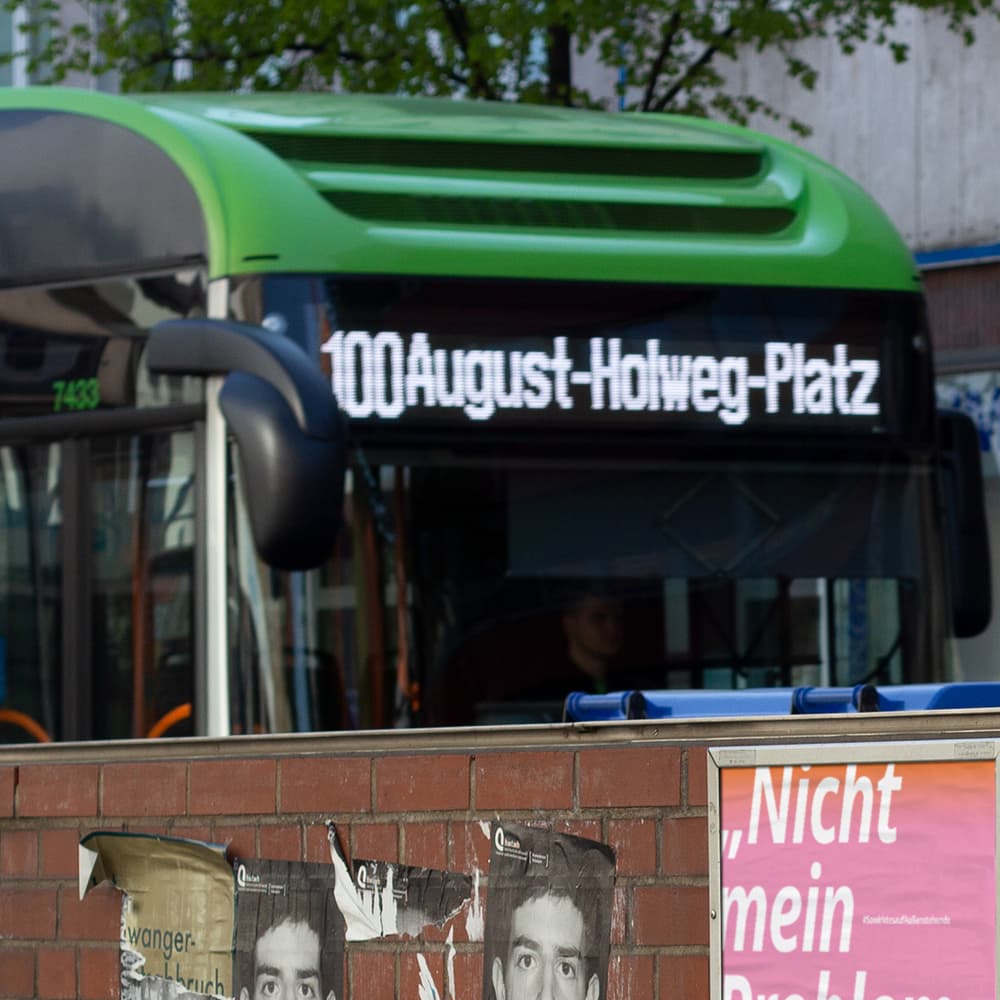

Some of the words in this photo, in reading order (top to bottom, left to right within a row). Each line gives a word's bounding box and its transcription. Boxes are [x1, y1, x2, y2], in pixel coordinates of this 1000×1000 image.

[320, 331, 404, 419] 100
[406, 332, 881, 426] August-Holweg-Platz
[722, 862, 854, 953] mein
